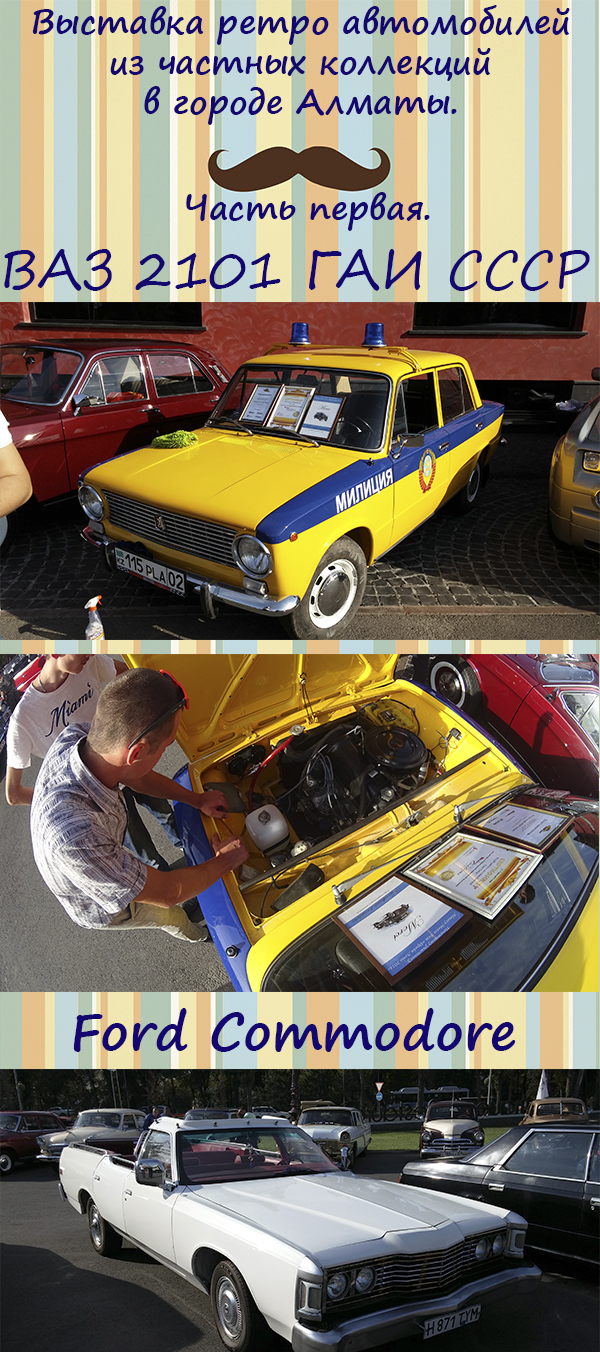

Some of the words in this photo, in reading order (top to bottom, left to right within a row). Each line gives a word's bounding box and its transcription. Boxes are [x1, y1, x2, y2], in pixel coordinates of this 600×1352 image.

[335, 468, 393, 513] МИЛИЦИЯ
[125, 554, 144, 573] 115
[145, 564, 167, 584] PLA
[168, 571, 184, 591] 02
[45, 682, 94, 737] Miami
[392, 914, 425, 941] Merci
[426, 1320, 435, 1336] H
[437, 1315, 455, 1332] 871
[459, 1307, 480, 1325] TYM
